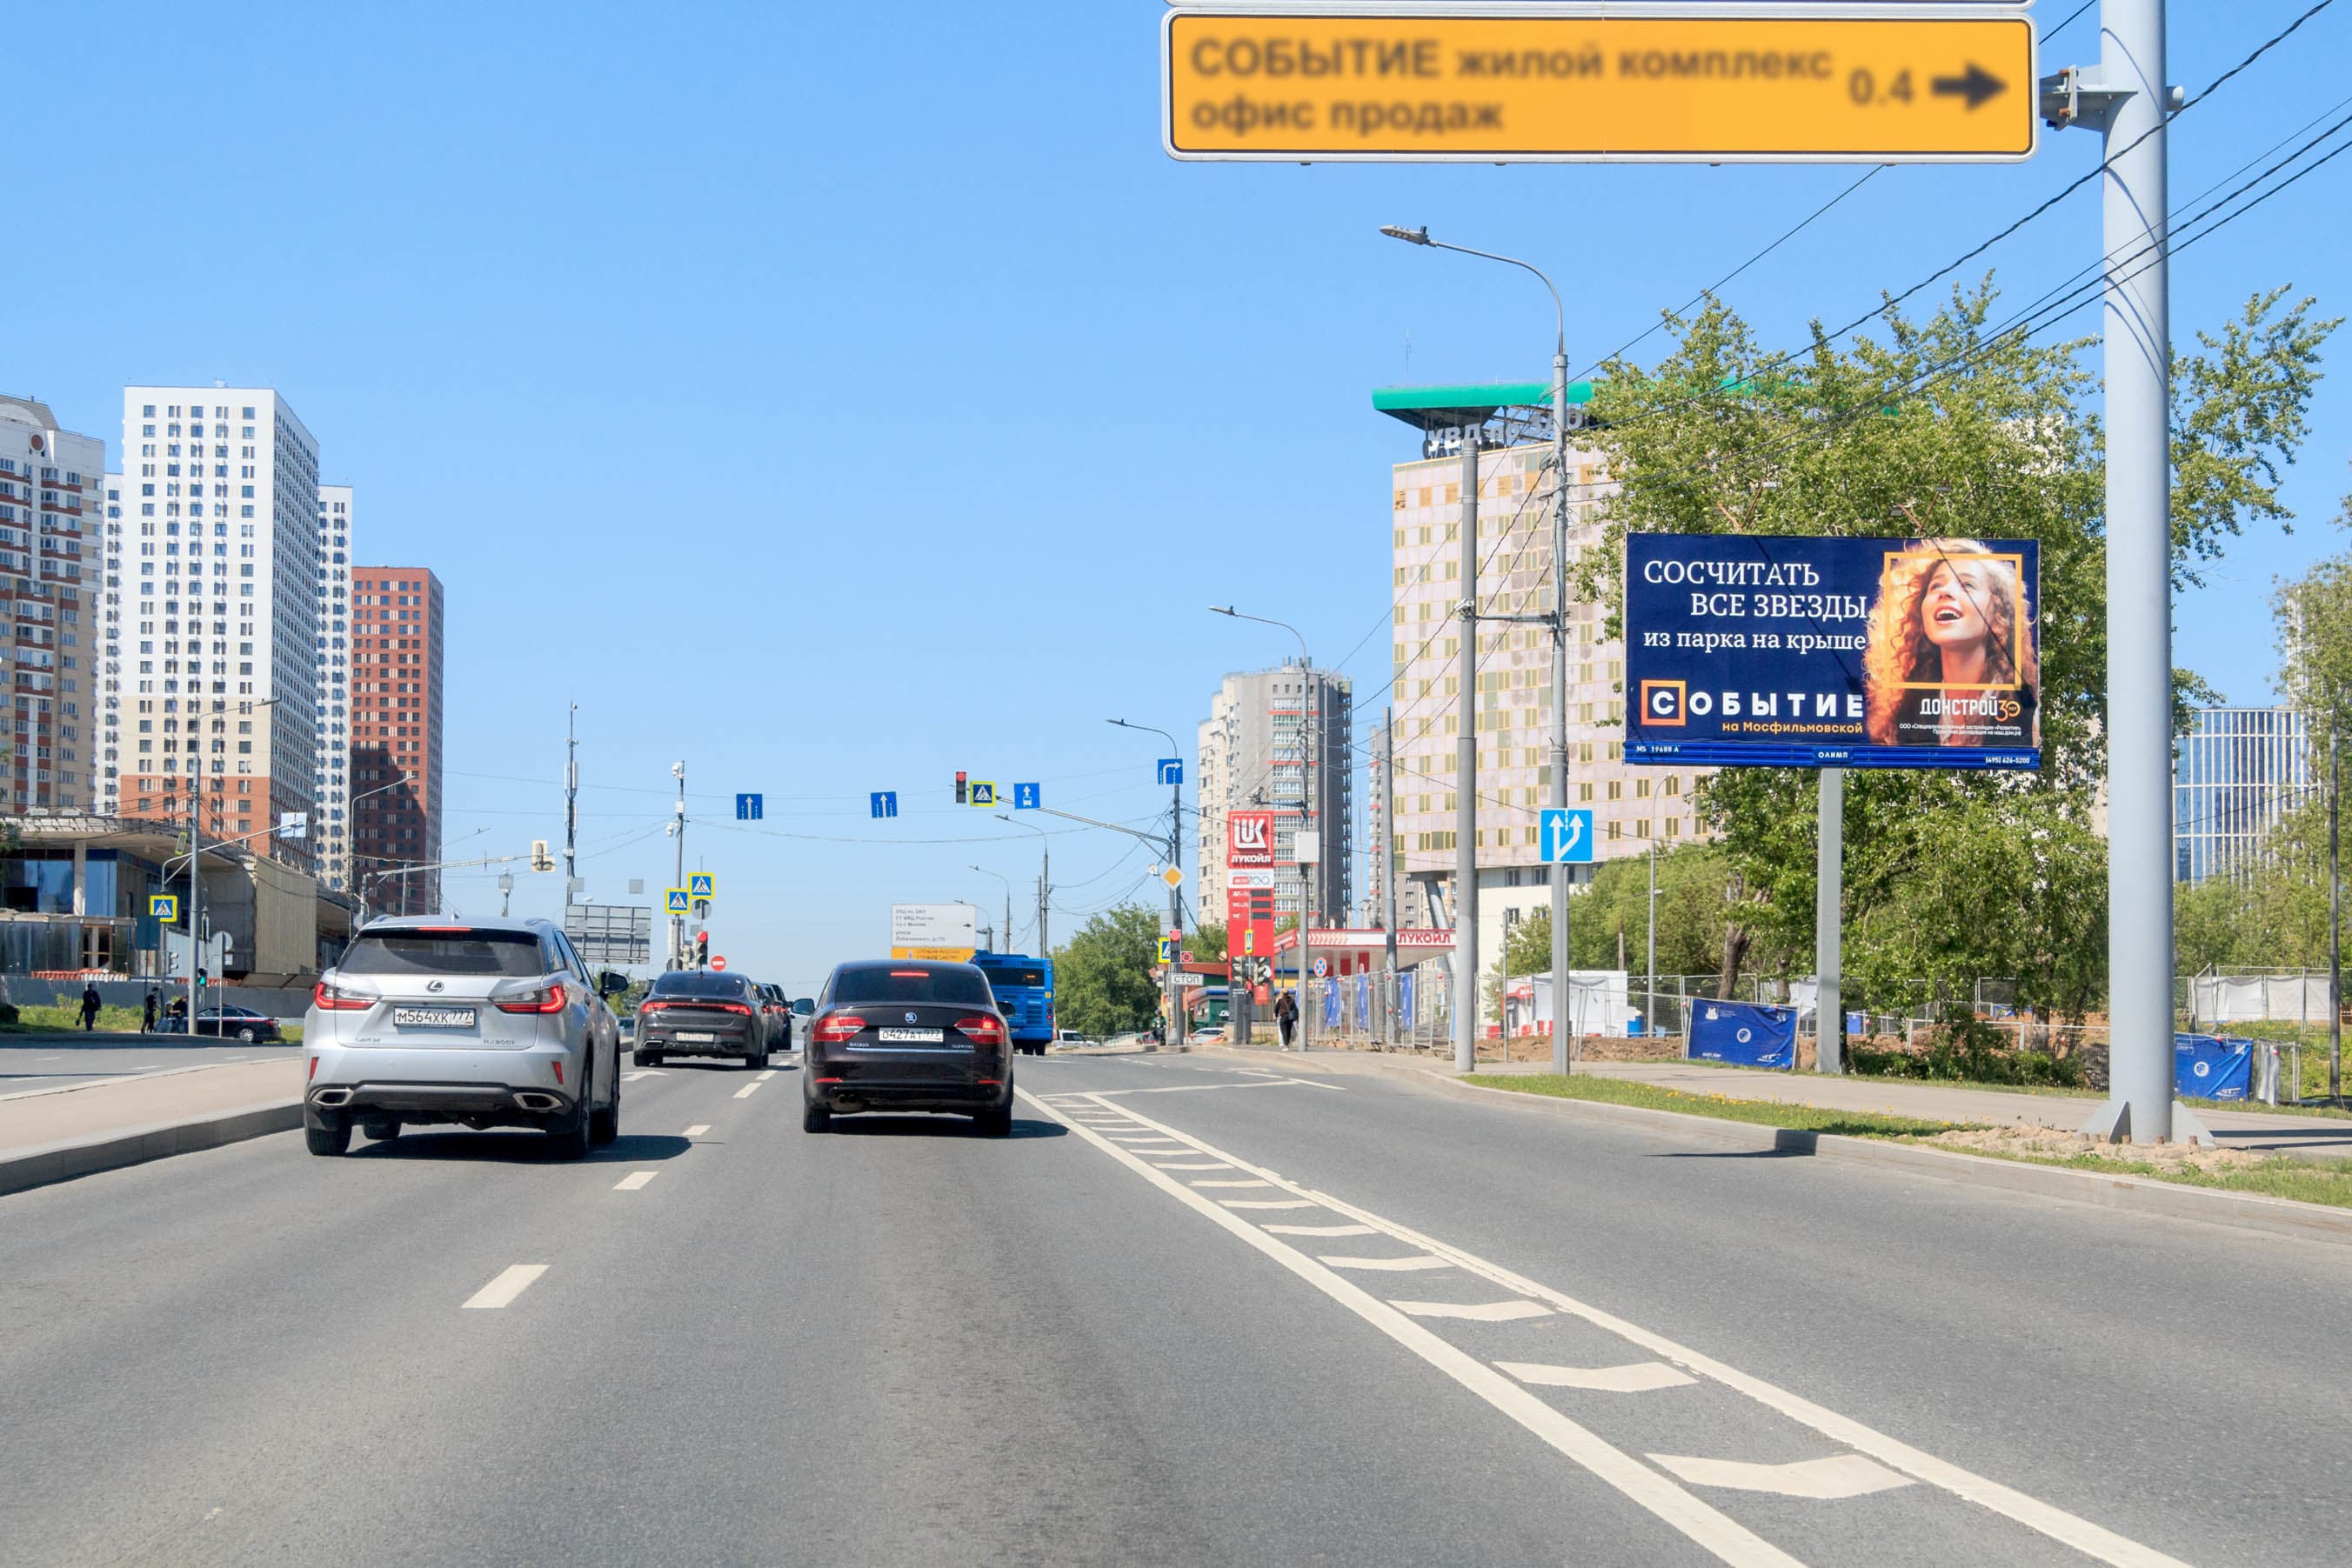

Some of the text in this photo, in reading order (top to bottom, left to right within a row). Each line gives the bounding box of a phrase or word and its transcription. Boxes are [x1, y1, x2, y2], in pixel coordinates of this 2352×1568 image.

[1190, 37, 1832, 79] СОБЫТИЕ жилой комплекс
[1191, 94, 1502, 137] офис продаж
[1644, 561, 1820, 586] СОСЧИТАТЬ
[1691, 593, 1868, 623] ВСЕ ЗВЕЗДЫ
[1643, 632, 1867, 655] из парка на крыше
[1652, 691, 1864, 717] СОБЫТИЕ
[1919, 696, 1998, 717] ДОНСТРОЙ
[1722, 721, 1864, 734] на Мосфильмовской
[1231, 852, 1272, 864] ЛУКОЙЛ
[1398, 931, 1451, 944] ЛУКОЙЛ
[451, 1010, 471, 1021] 777
